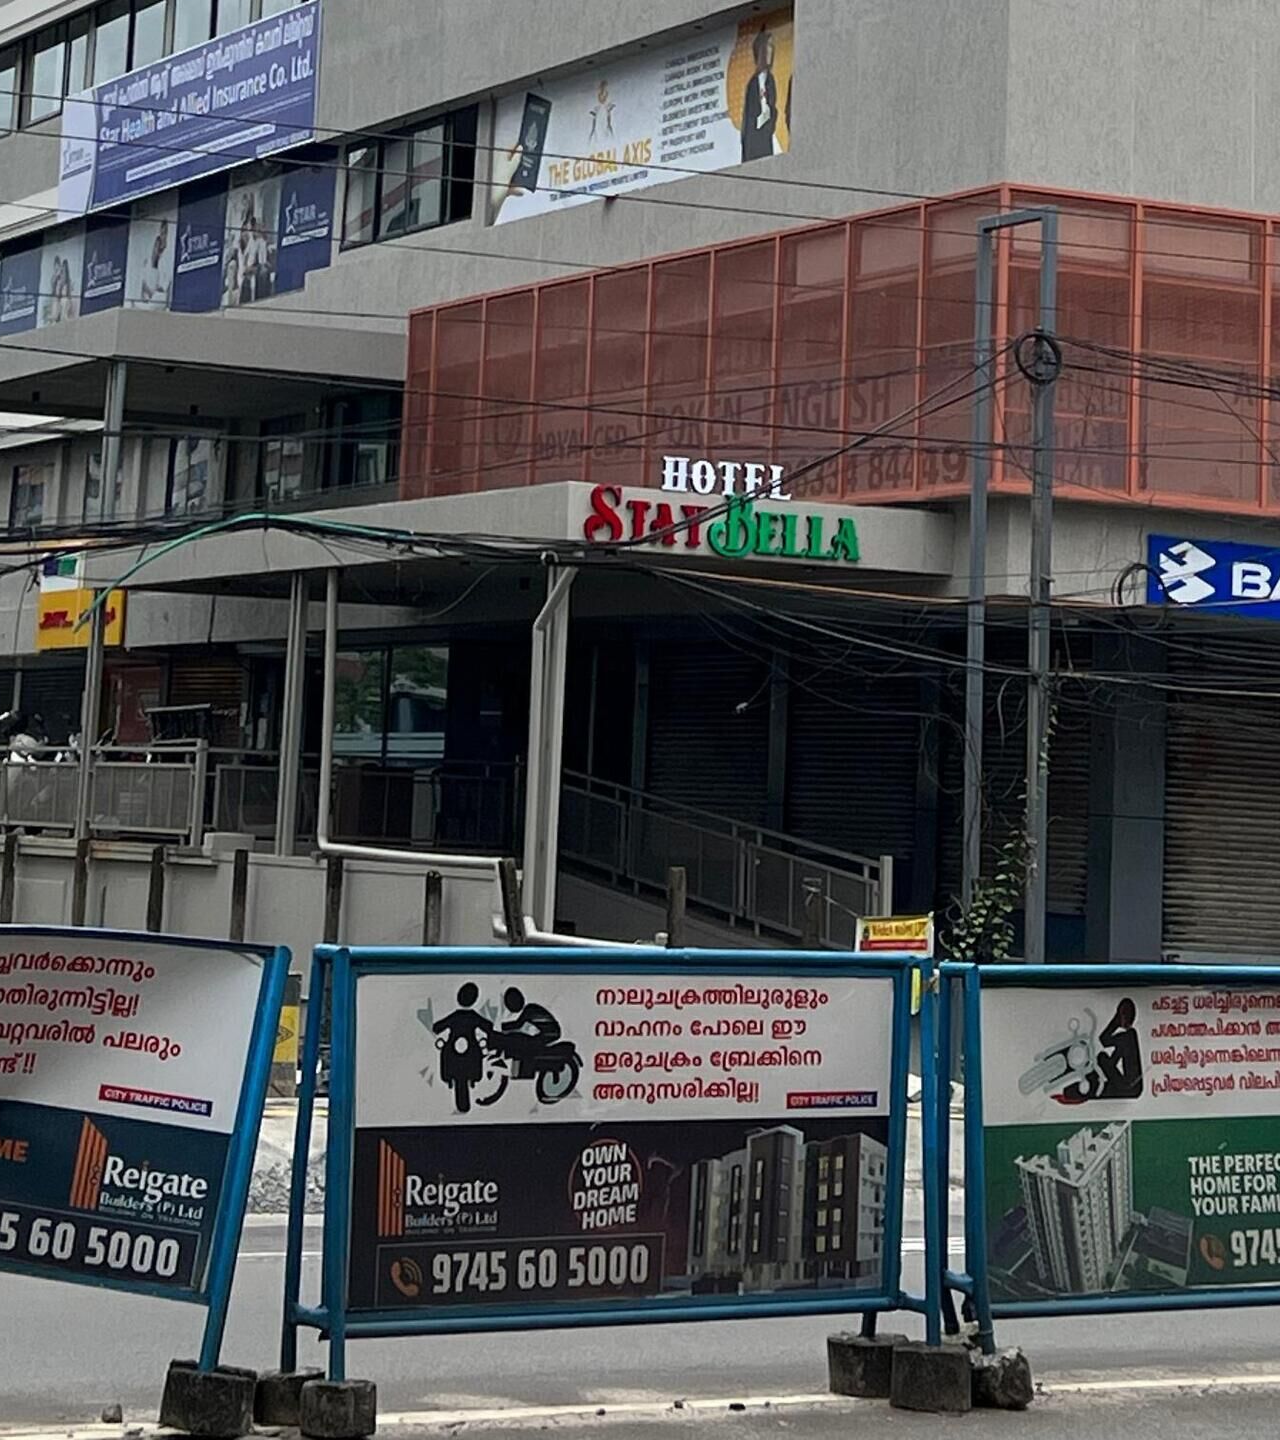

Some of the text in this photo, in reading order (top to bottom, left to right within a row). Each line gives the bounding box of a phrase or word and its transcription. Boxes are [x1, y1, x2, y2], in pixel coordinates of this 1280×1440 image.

[100, 50, 314, 152] Star Health and Allied Insurance Co. Ltd.
[549, 160, 570, 187] THE
[573, 148, 618, 181] GLOBAL
[623, 138, 652, 164] AXIS
[293, 204, 316, 224] STAR
[189, 234, 209, 252] STAR
[661, 455, 792, 501] HOTEL
[596, 984, 829, 1010] നാലുചക്രത്തിലുരുളും
[595, 1019, 807, 1039] വാഹനം പോലെ ഈ
[104, 1031, 181, 1061] പലരും
[594, 1045, 822, 1073] ഇരുചക്രം ബ്രേക്കിനെ
[104, 1088, 208, 1113] CITY TRAFFIC POLICE
[593, 1077, 760, 1104] അനുസരിക്കില്ല!
[581, 1143, 627, 1167] OWN
[1188, 1156, 1221, 1175] THE
[103, 1155, 208, 1202] Reigate
[582, 1163, 632, 1187] YOUR
[1190, 1174, 1277, 1195] HOME FOR
[100, 1192, 153, 1213] Builders
[157, 1197, 175, 1216] (P)
[178, 1205, 204, 1220] Ltd
[405, 1174, 498, 1216] Reigate
[573, 1183, 639, 1211] DREAM
[1191, 1197, 1238, 1216] YOUR
[405, 1210, 498, 1228] Builders (P) Ltd
[581, 1204, 636, 1230] HOME
[28, 1219, 75, 1260] 60
[84, 1228, 180, 1277] 5000
[432, 1245, 649, 1294] 9745 60 5000
